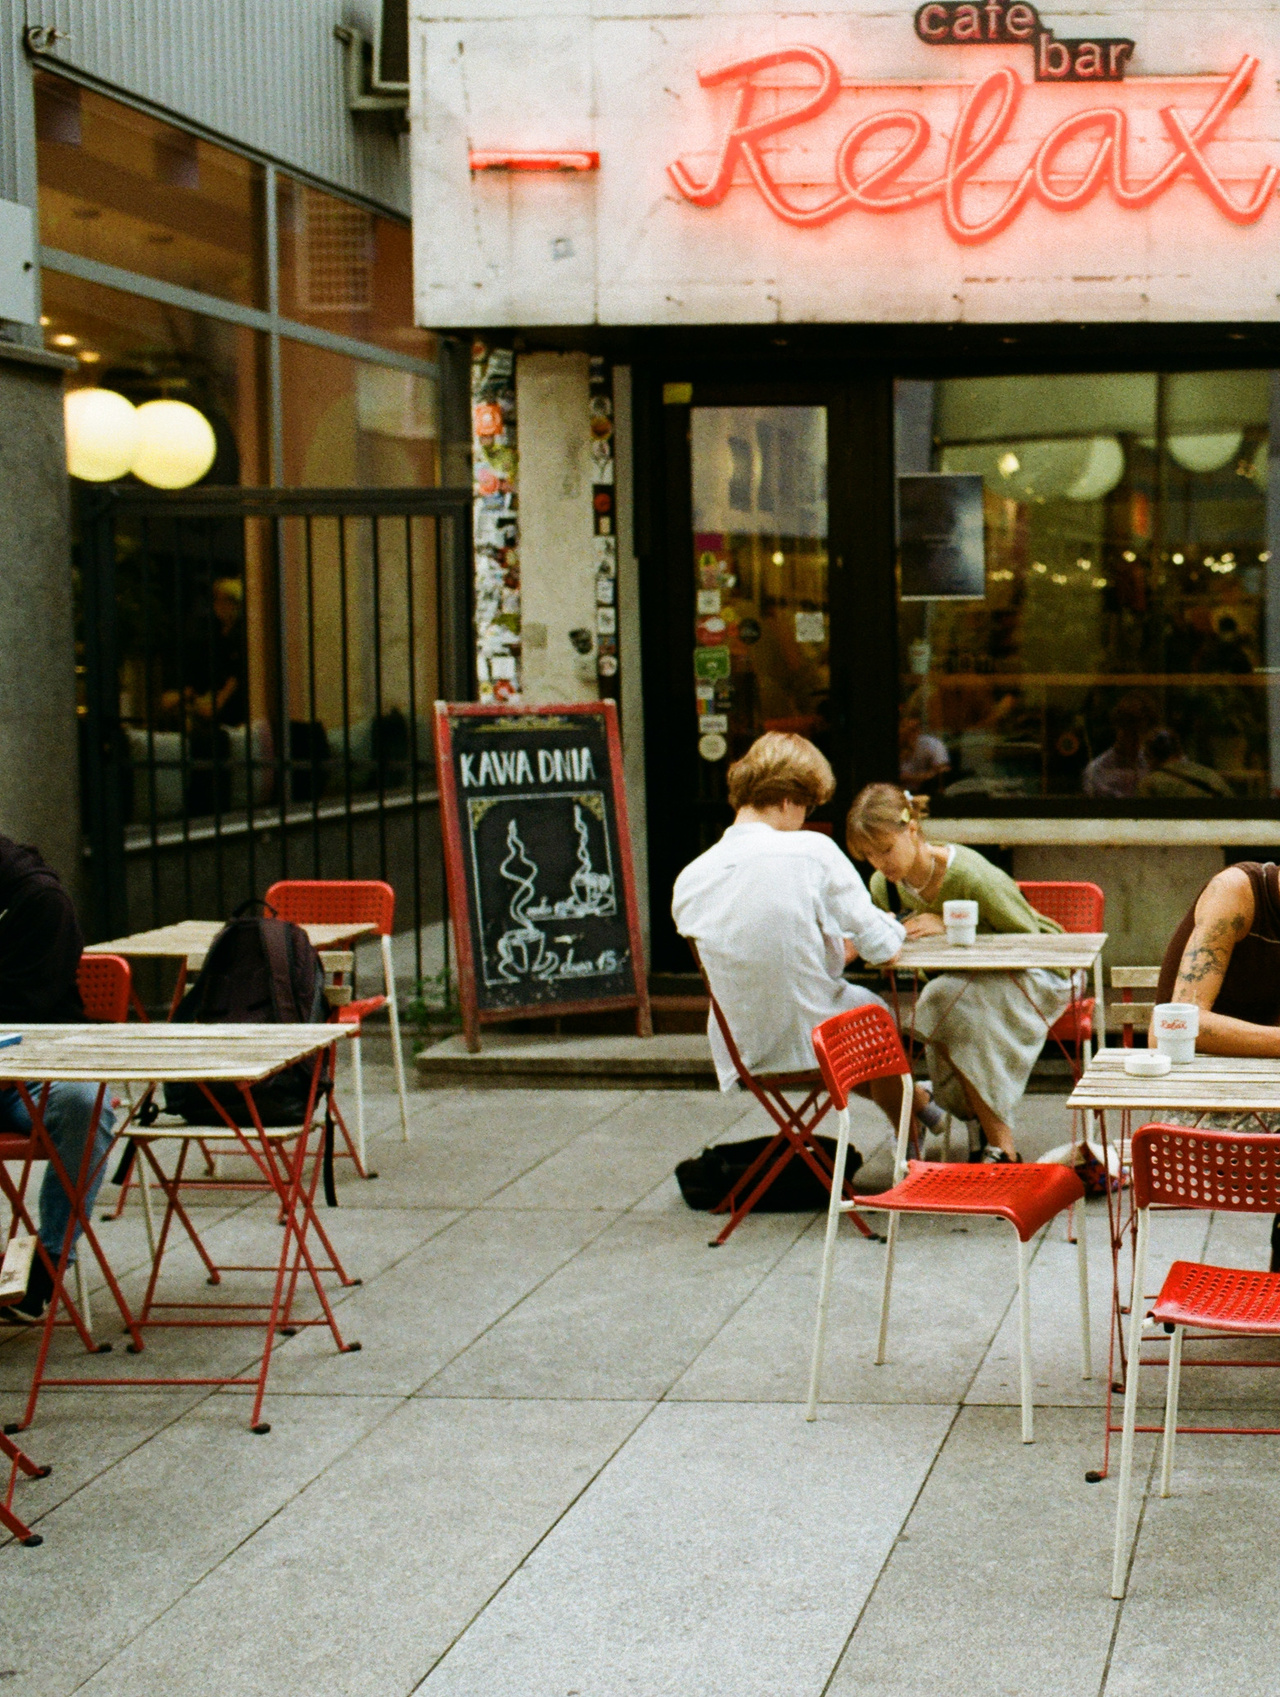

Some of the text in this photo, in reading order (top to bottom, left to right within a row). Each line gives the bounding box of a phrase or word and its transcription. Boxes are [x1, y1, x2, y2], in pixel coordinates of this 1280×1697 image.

[919, 0, 1036, 40] cafe
[1039, 32, 1130, 77] bar
[460, 746, 598, 788] KAWA DNIA
